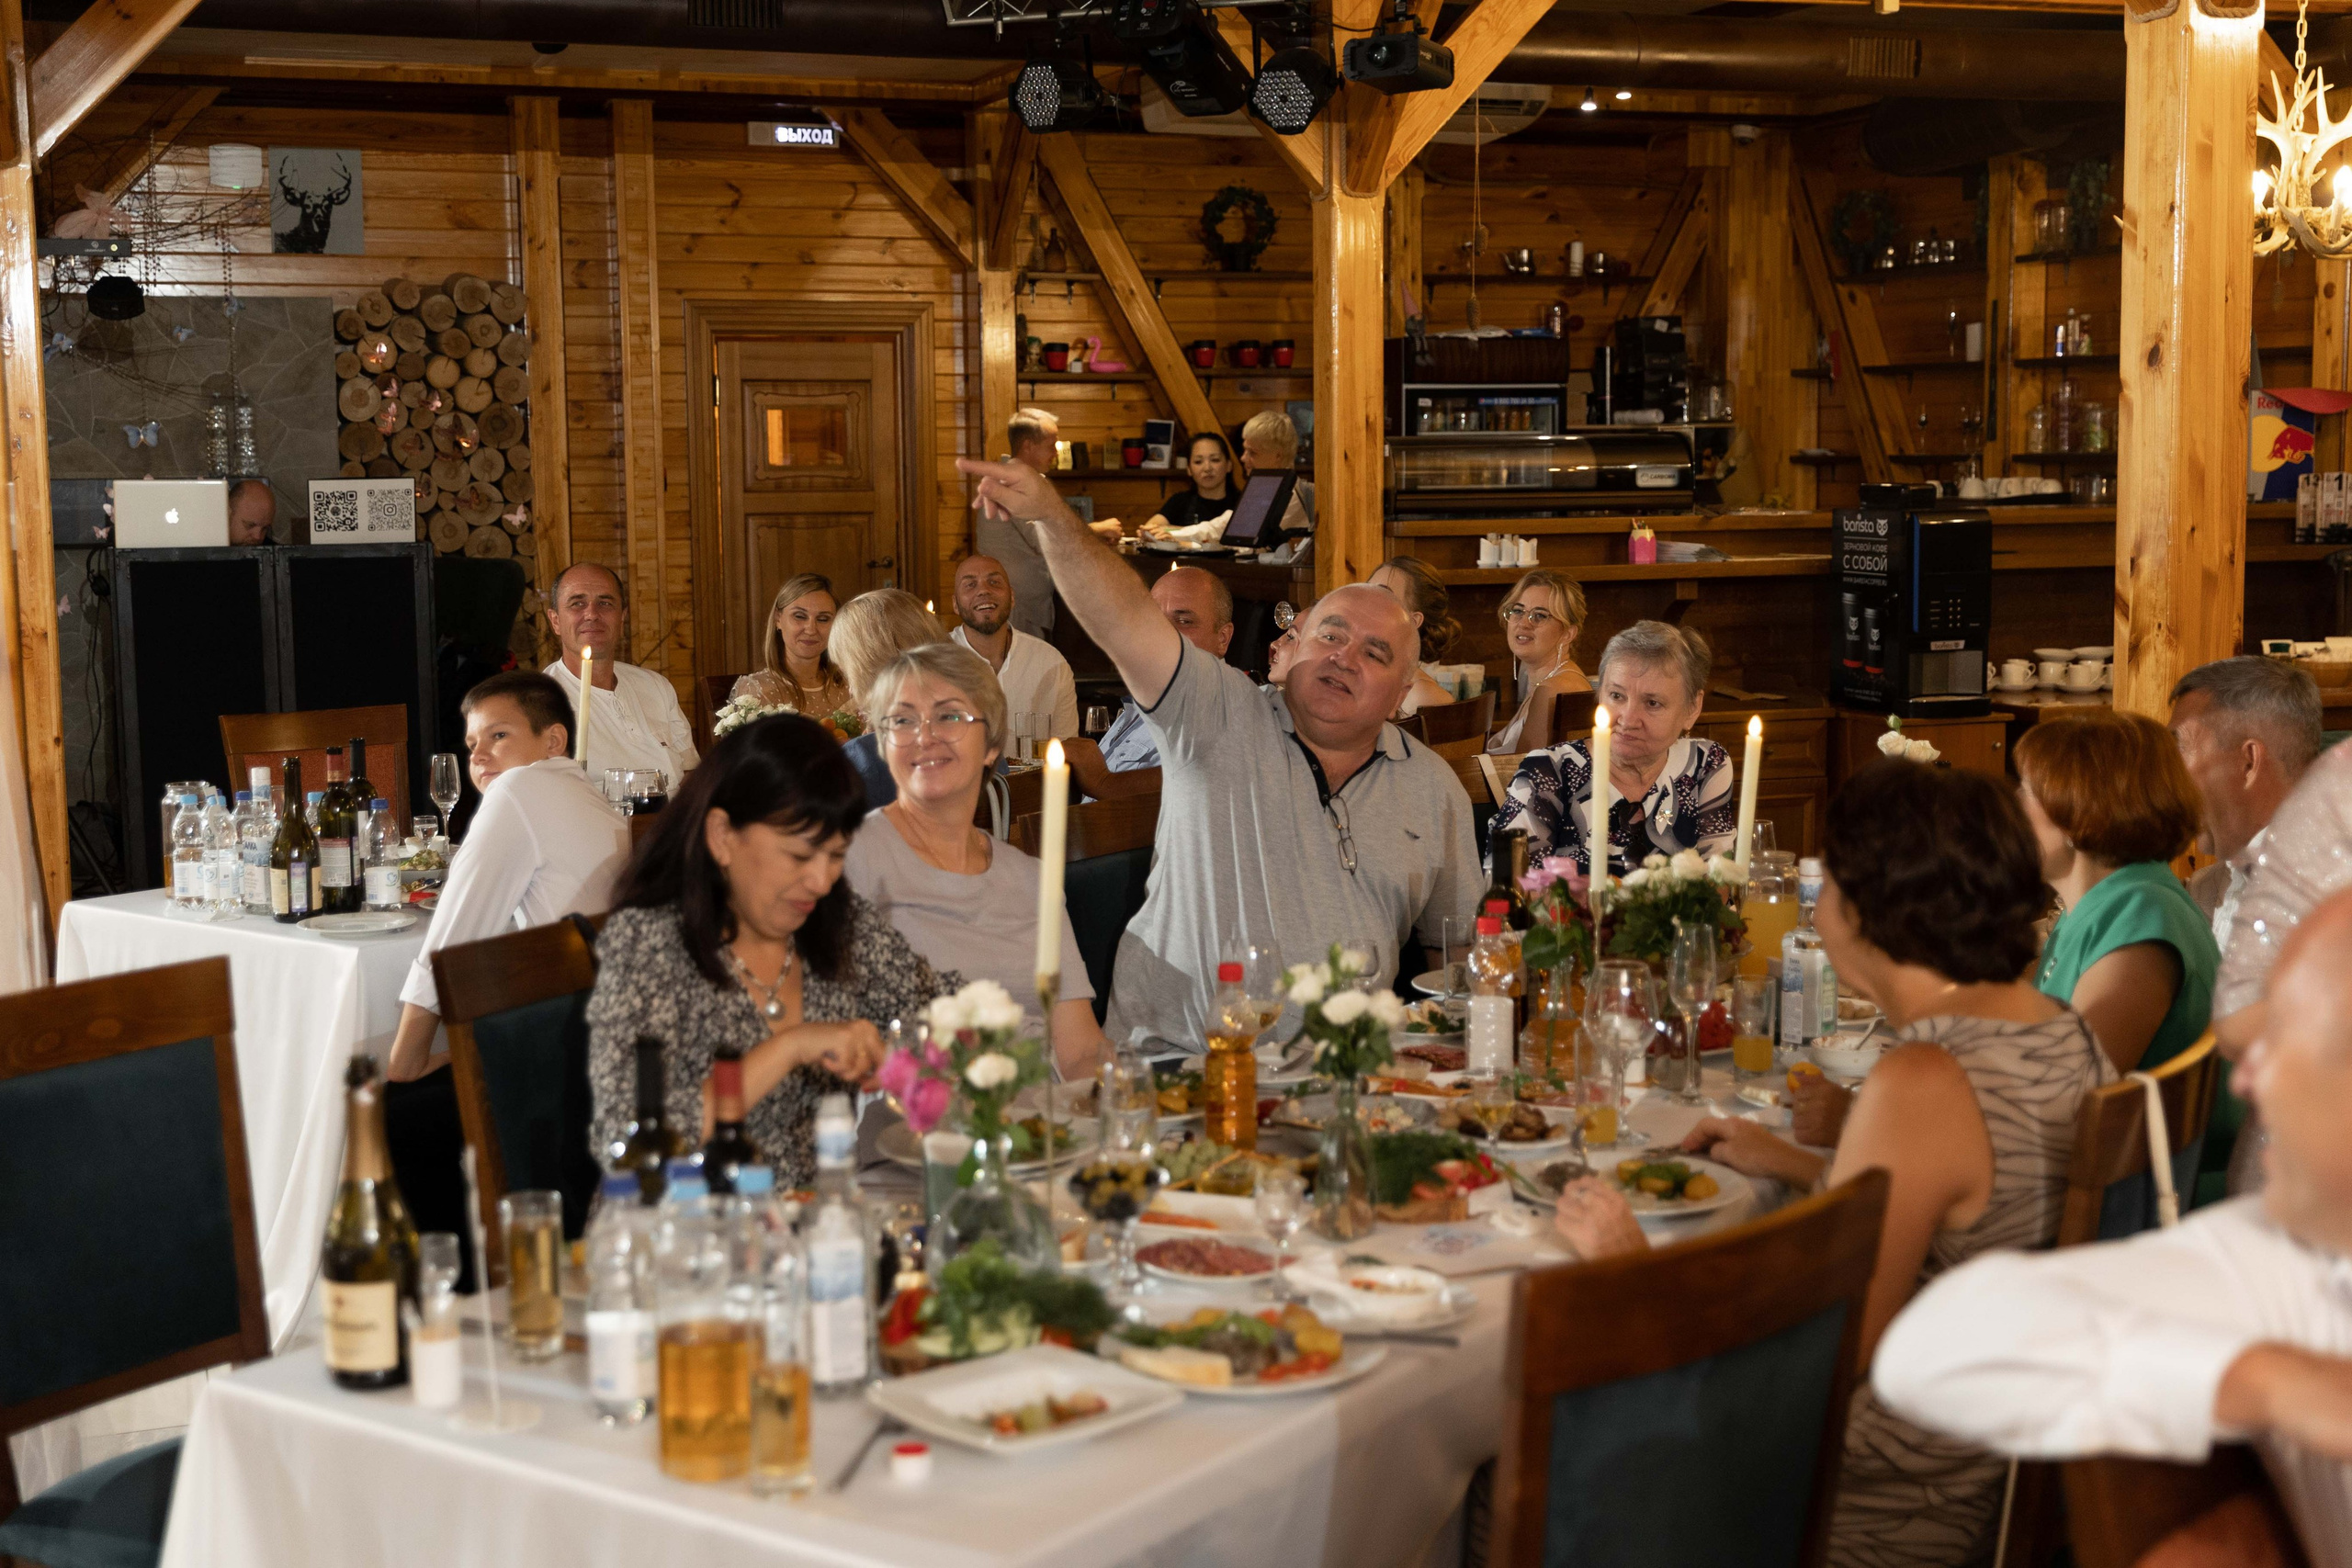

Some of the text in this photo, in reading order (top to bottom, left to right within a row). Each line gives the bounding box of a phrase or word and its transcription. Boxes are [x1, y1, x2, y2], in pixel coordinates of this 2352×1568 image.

[1843, 513, 1874, 533] barista
[1843, 542, 1888, 553] ЗЕРНОВОЙ КОФЕ
[1843, 554, 1887, 571] С СОБОЙ
